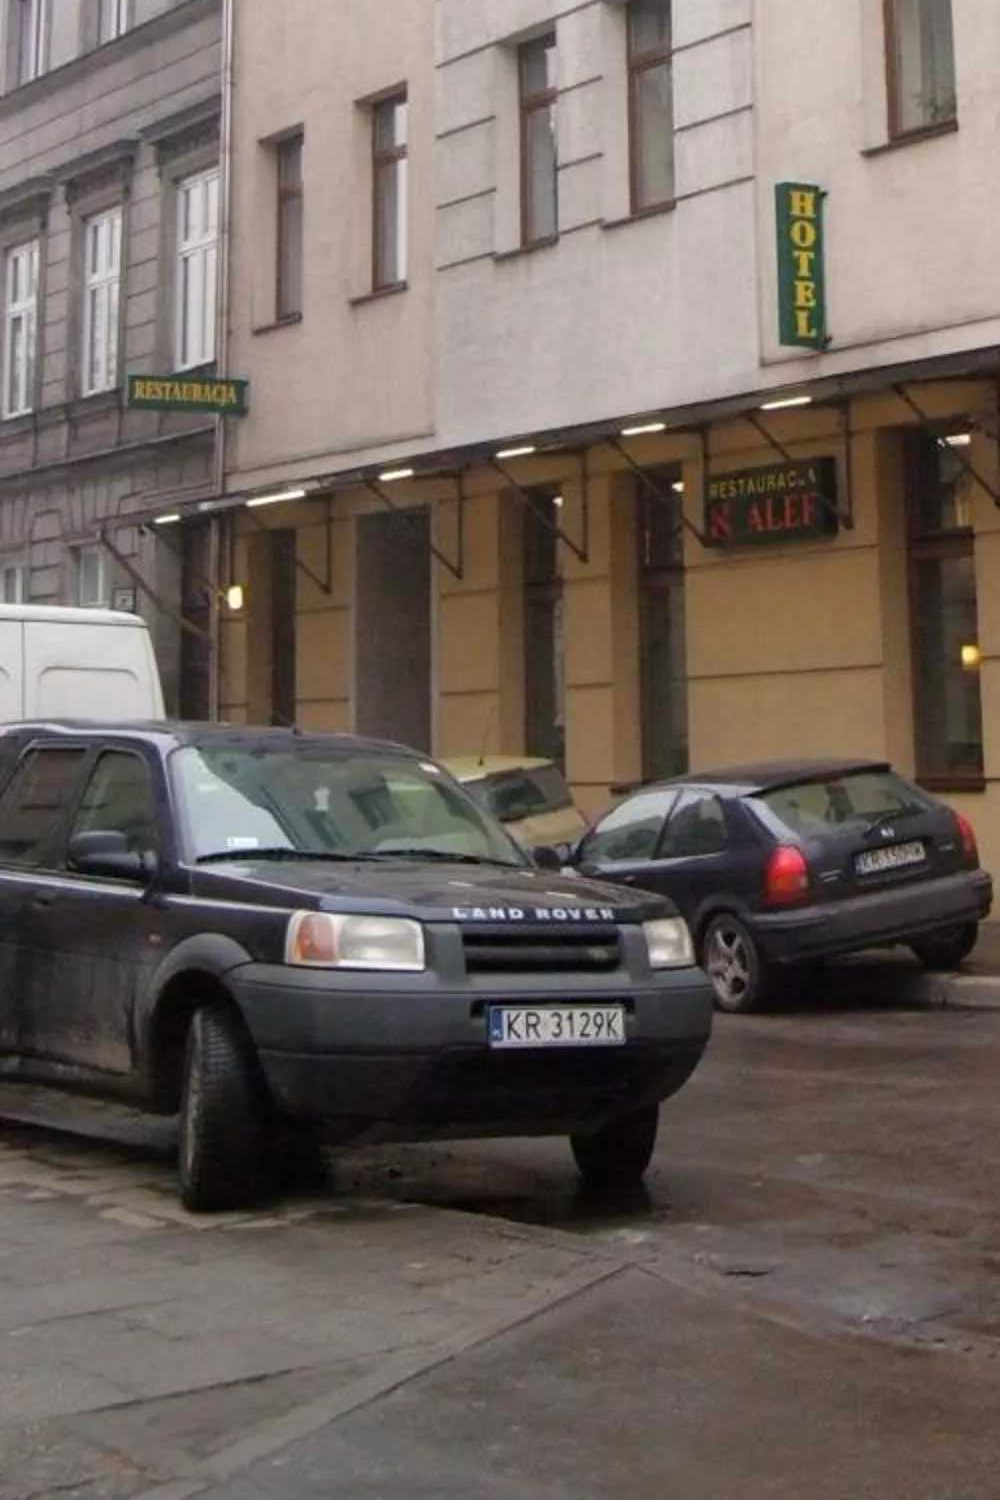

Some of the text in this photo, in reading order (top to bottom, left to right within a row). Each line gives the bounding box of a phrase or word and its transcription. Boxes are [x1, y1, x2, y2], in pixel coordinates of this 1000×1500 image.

[790, 190, 817, 338] HOTEL
[134, 380, 237, 406] RESTAURACJA
[709, 468, 816, 499] RESTAURAC
[452, 906, 615, 921] LAND ROVER
[507, 1011, 619, 1040] KR 3129K
